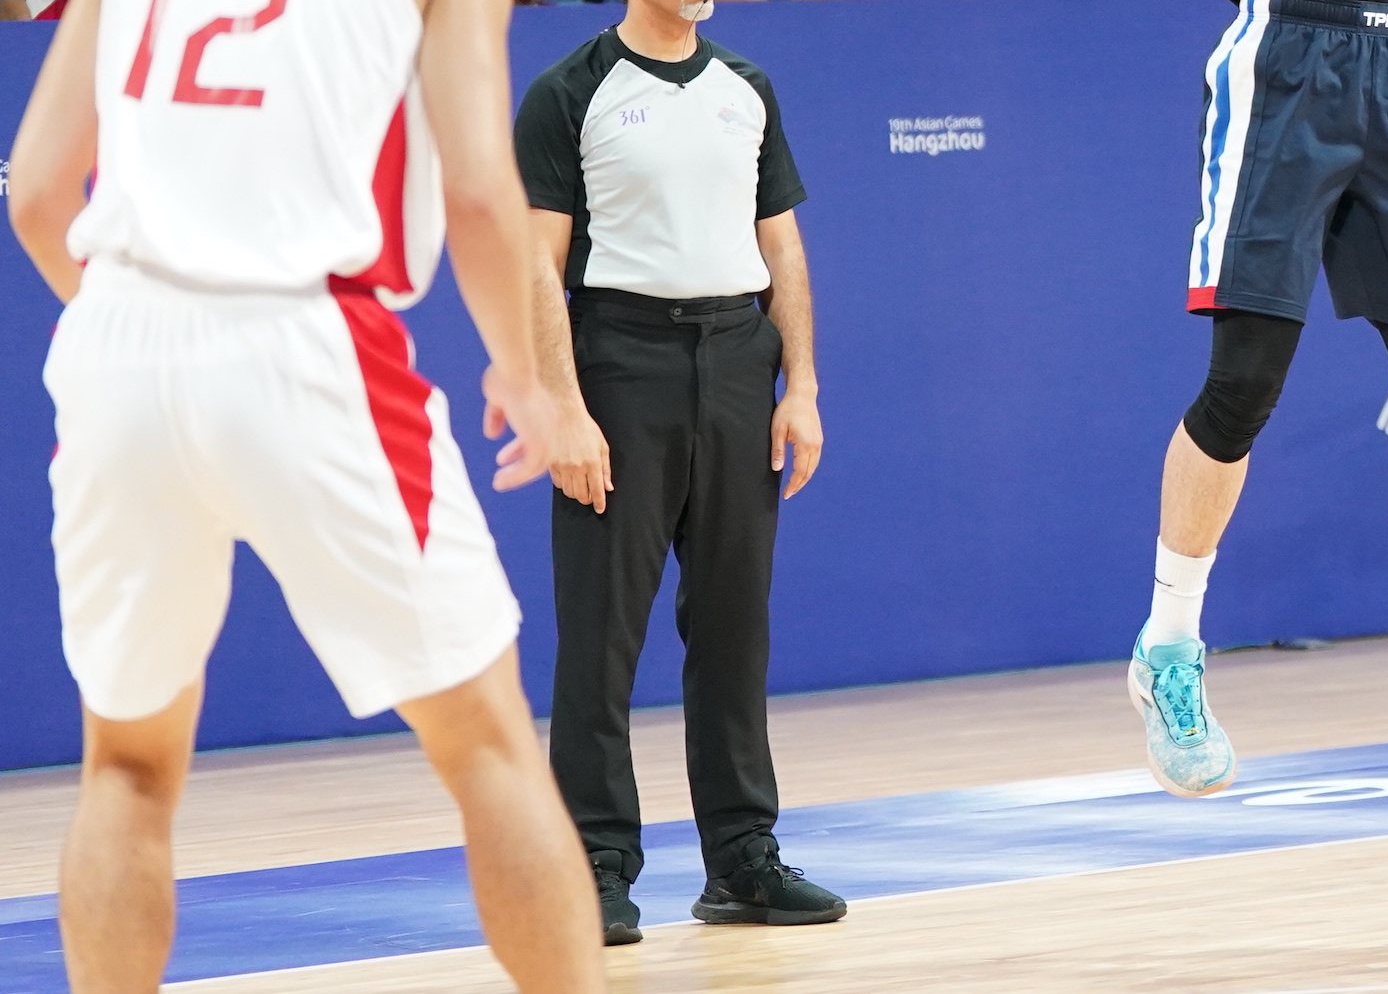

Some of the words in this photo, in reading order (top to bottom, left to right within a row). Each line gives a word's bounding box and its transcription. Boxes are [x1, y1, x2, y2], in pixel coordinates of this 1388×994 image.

[888, 117, 912, 132] 19th
[914, 116, 943, 131] Asian
[944, 114, 984, 130] Games
[889, 130, 985, 156] Hangzhou
